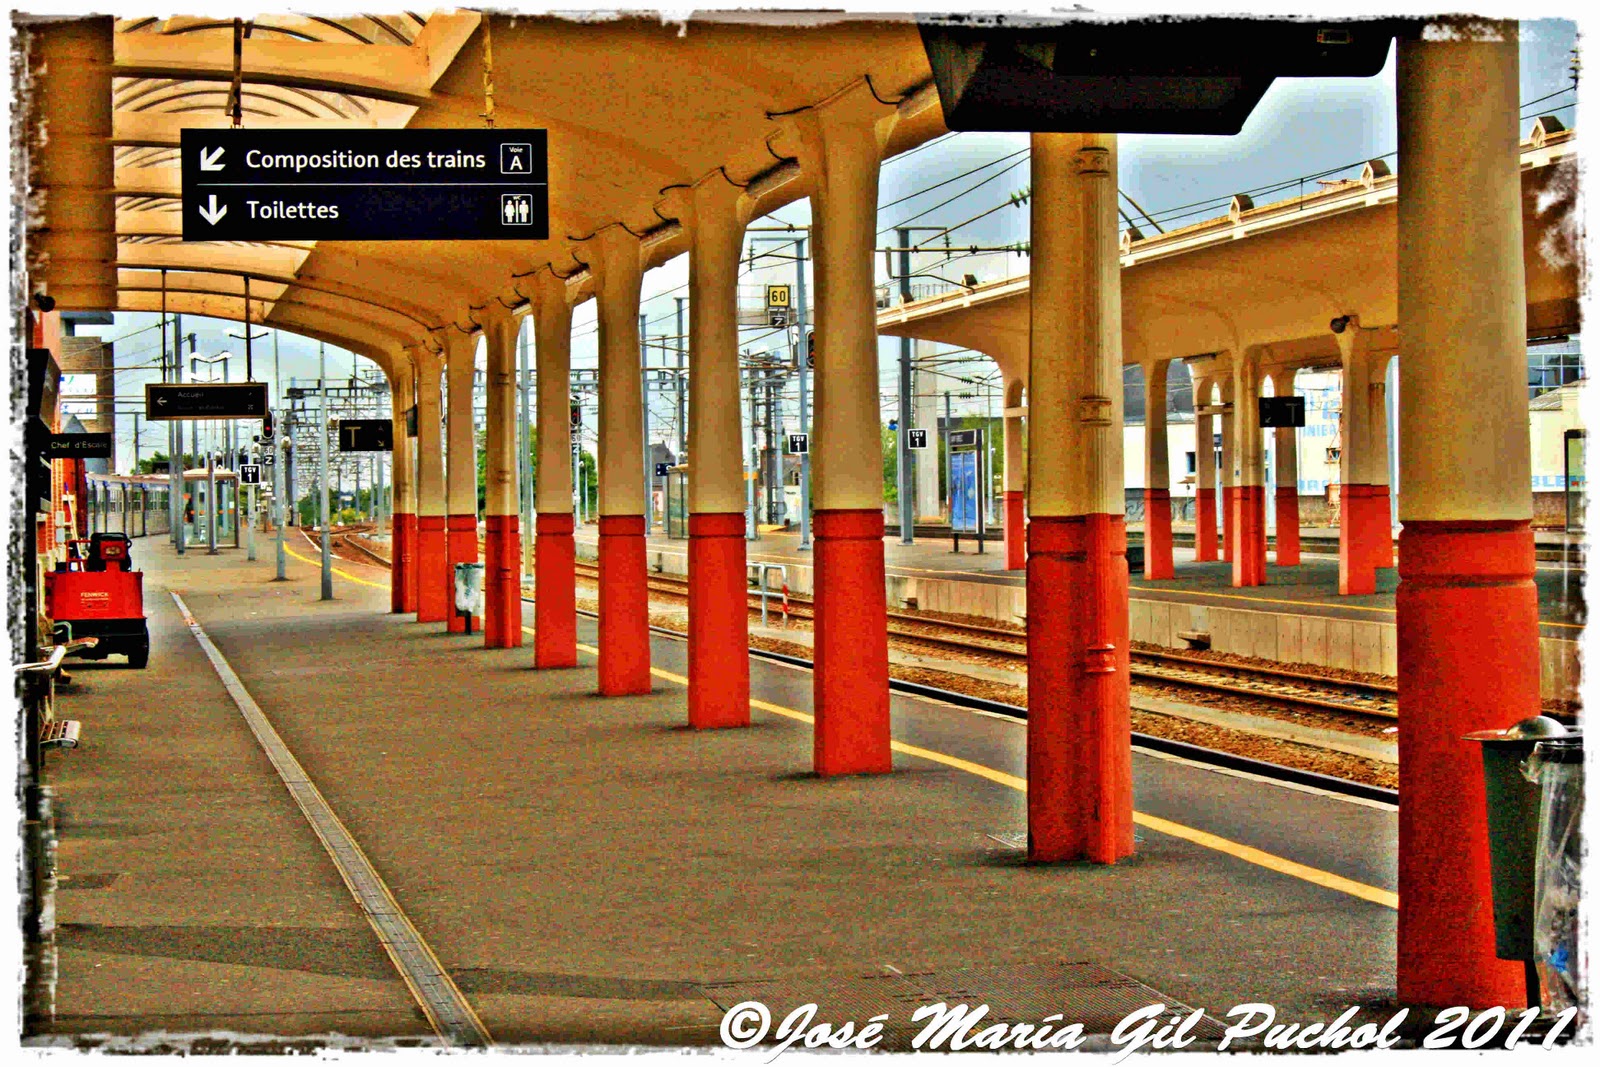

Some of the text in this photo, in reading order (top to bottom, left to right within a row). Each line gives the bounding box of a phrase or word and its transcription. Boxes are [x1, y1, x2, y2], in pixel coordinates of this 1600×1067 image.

[246, 149, 486, 173] Composition des trains
[510, 155, 523, 171] A
[246, 200, 339, 220] Toilettes
[772, 291, 786, 302] 60
[177, 391, 204, 399] Accueil
[344, 426, 362, 448] T
[50, 441, 70, 449] Chef
[795, 442, 800, 452] 1
[914, 438, 920, 447] 1
[265, 456, 272, 465] Z
[247, 473, 253, 483] 1
